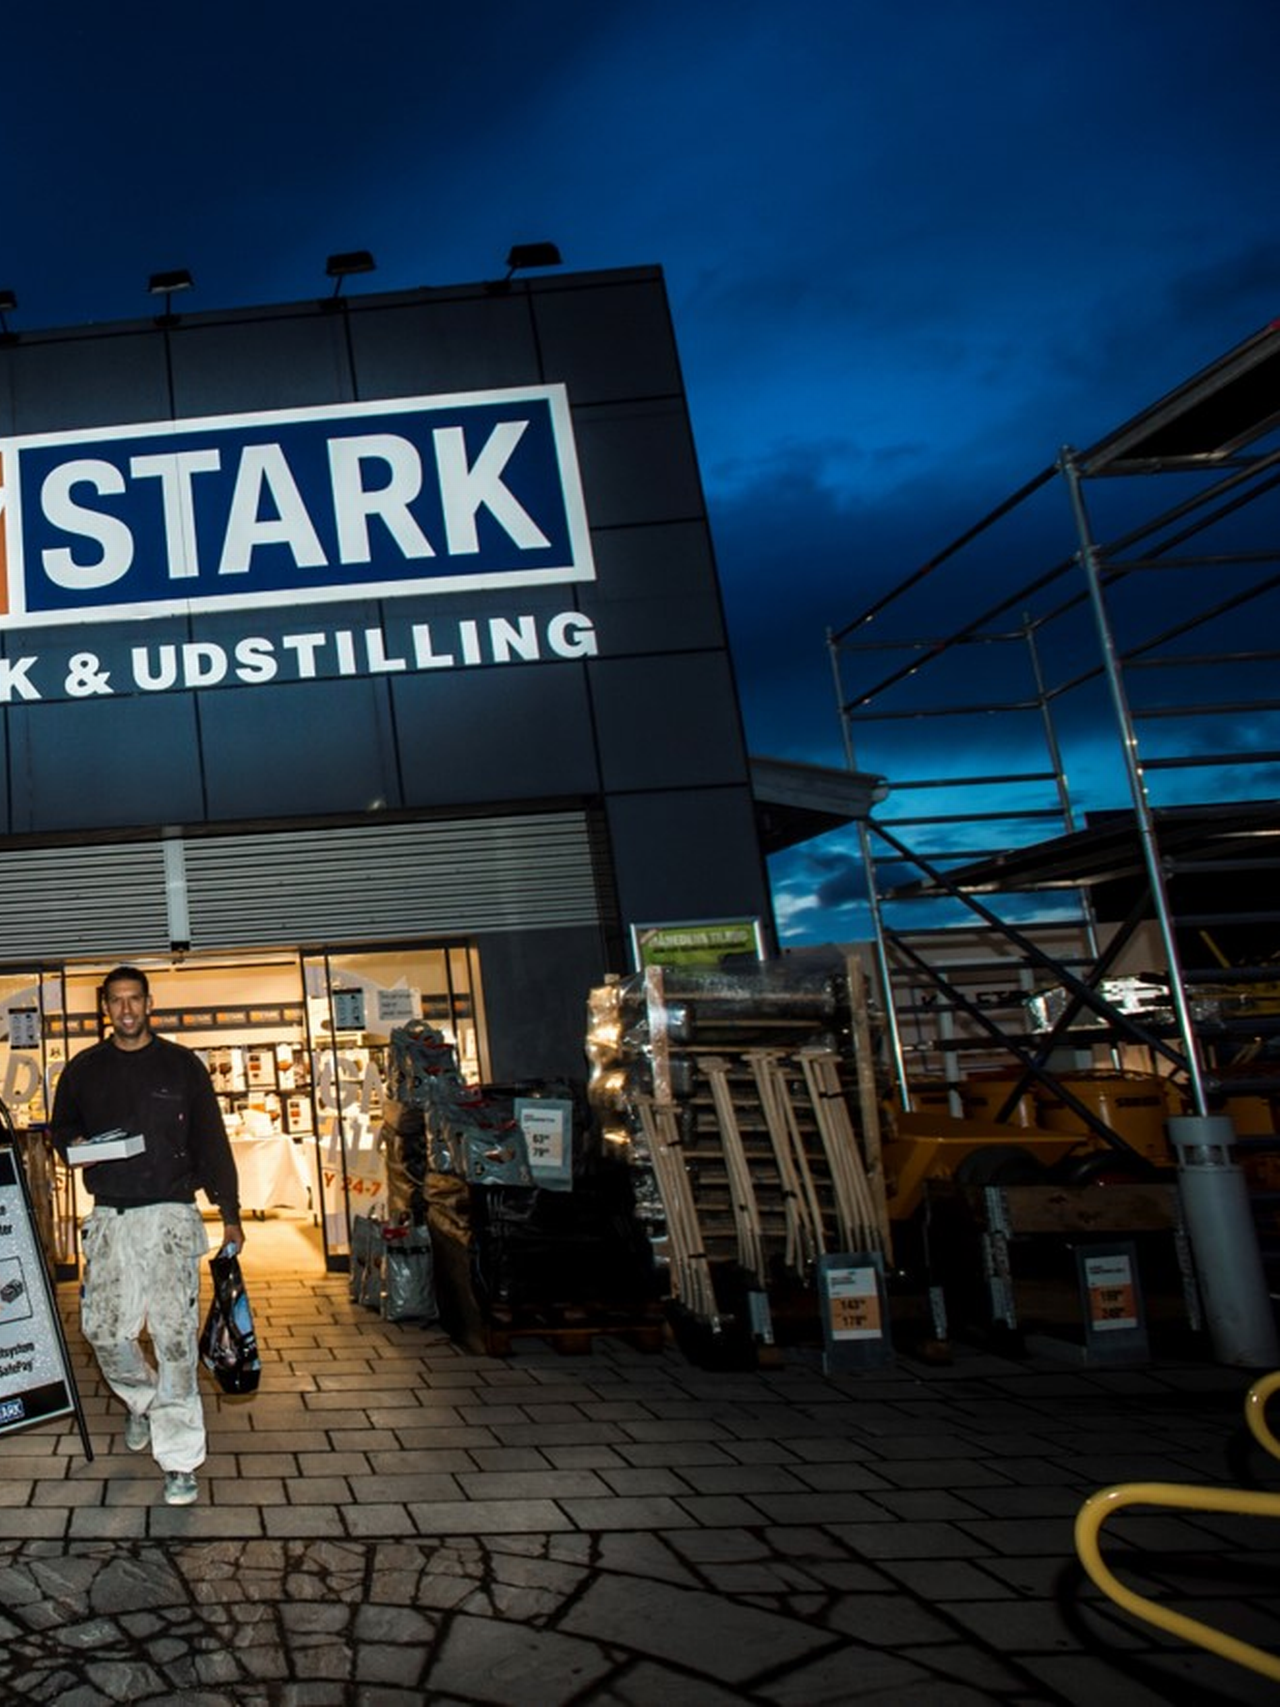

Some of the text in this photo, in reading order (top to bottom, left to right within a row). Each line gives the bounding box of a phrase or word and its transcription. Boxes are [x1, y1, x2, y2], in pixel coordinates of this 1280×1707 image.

[40, 420, 551, 590] STARK
[64, 653, 114, 698] &
[130, 611, 599, 692] UDSTILLING
